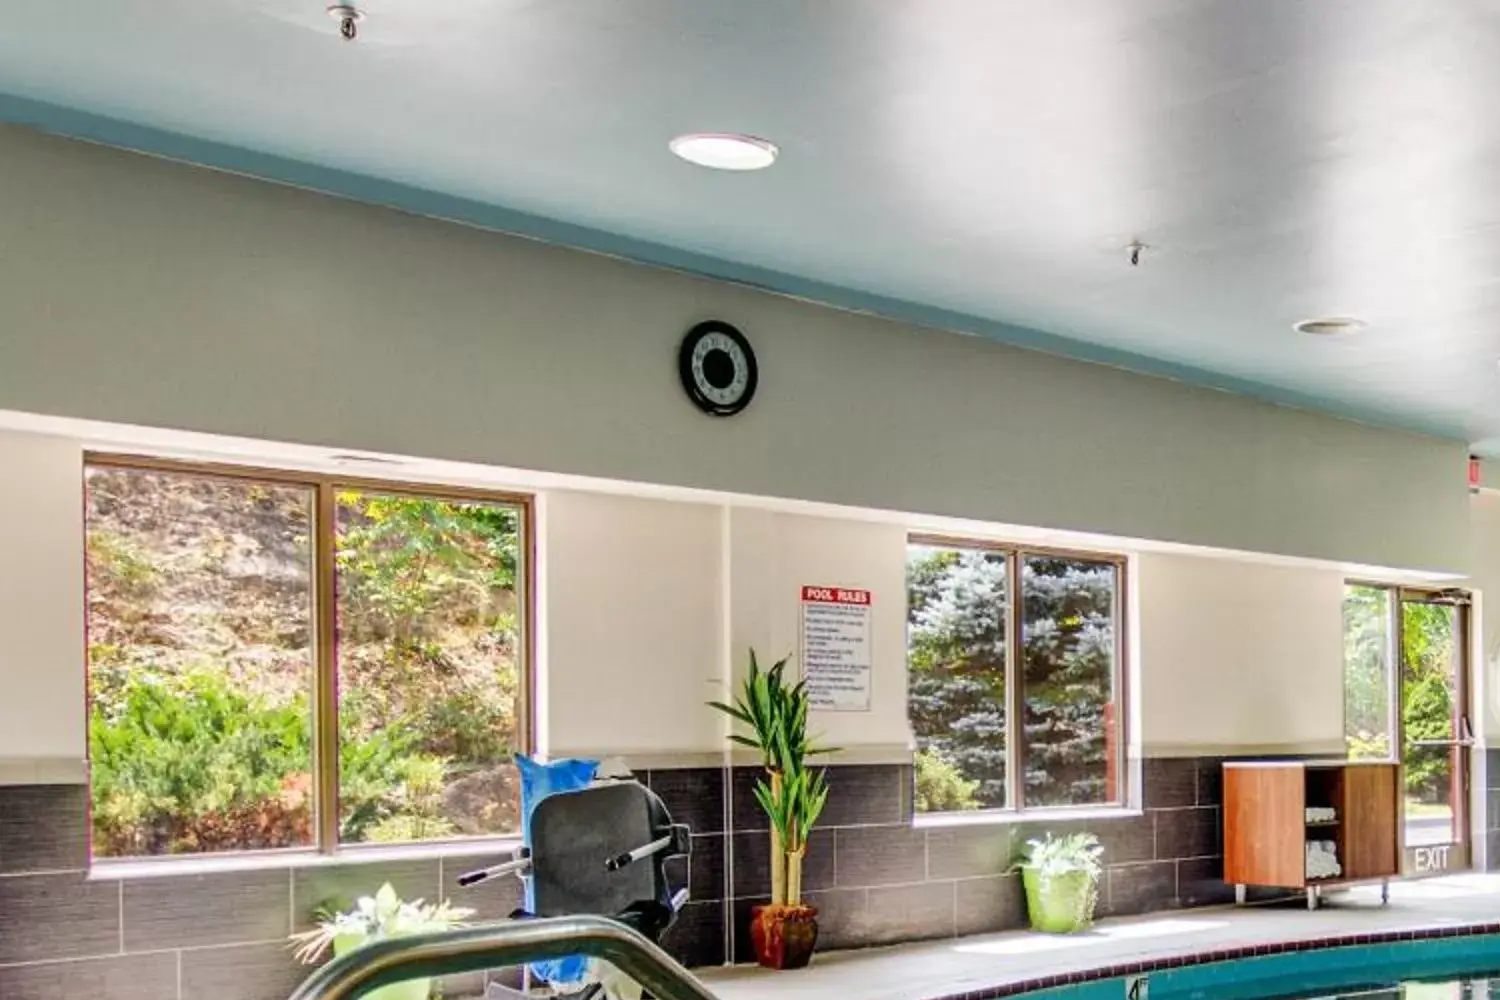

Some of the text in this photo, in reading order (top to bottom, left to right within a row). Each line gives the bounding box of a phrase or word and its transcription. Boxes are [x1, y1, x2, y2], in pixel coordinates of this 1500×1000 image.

[806, 588, 867, 603] POOL RULES
[1415, 846, 1450, 872] EXIT
